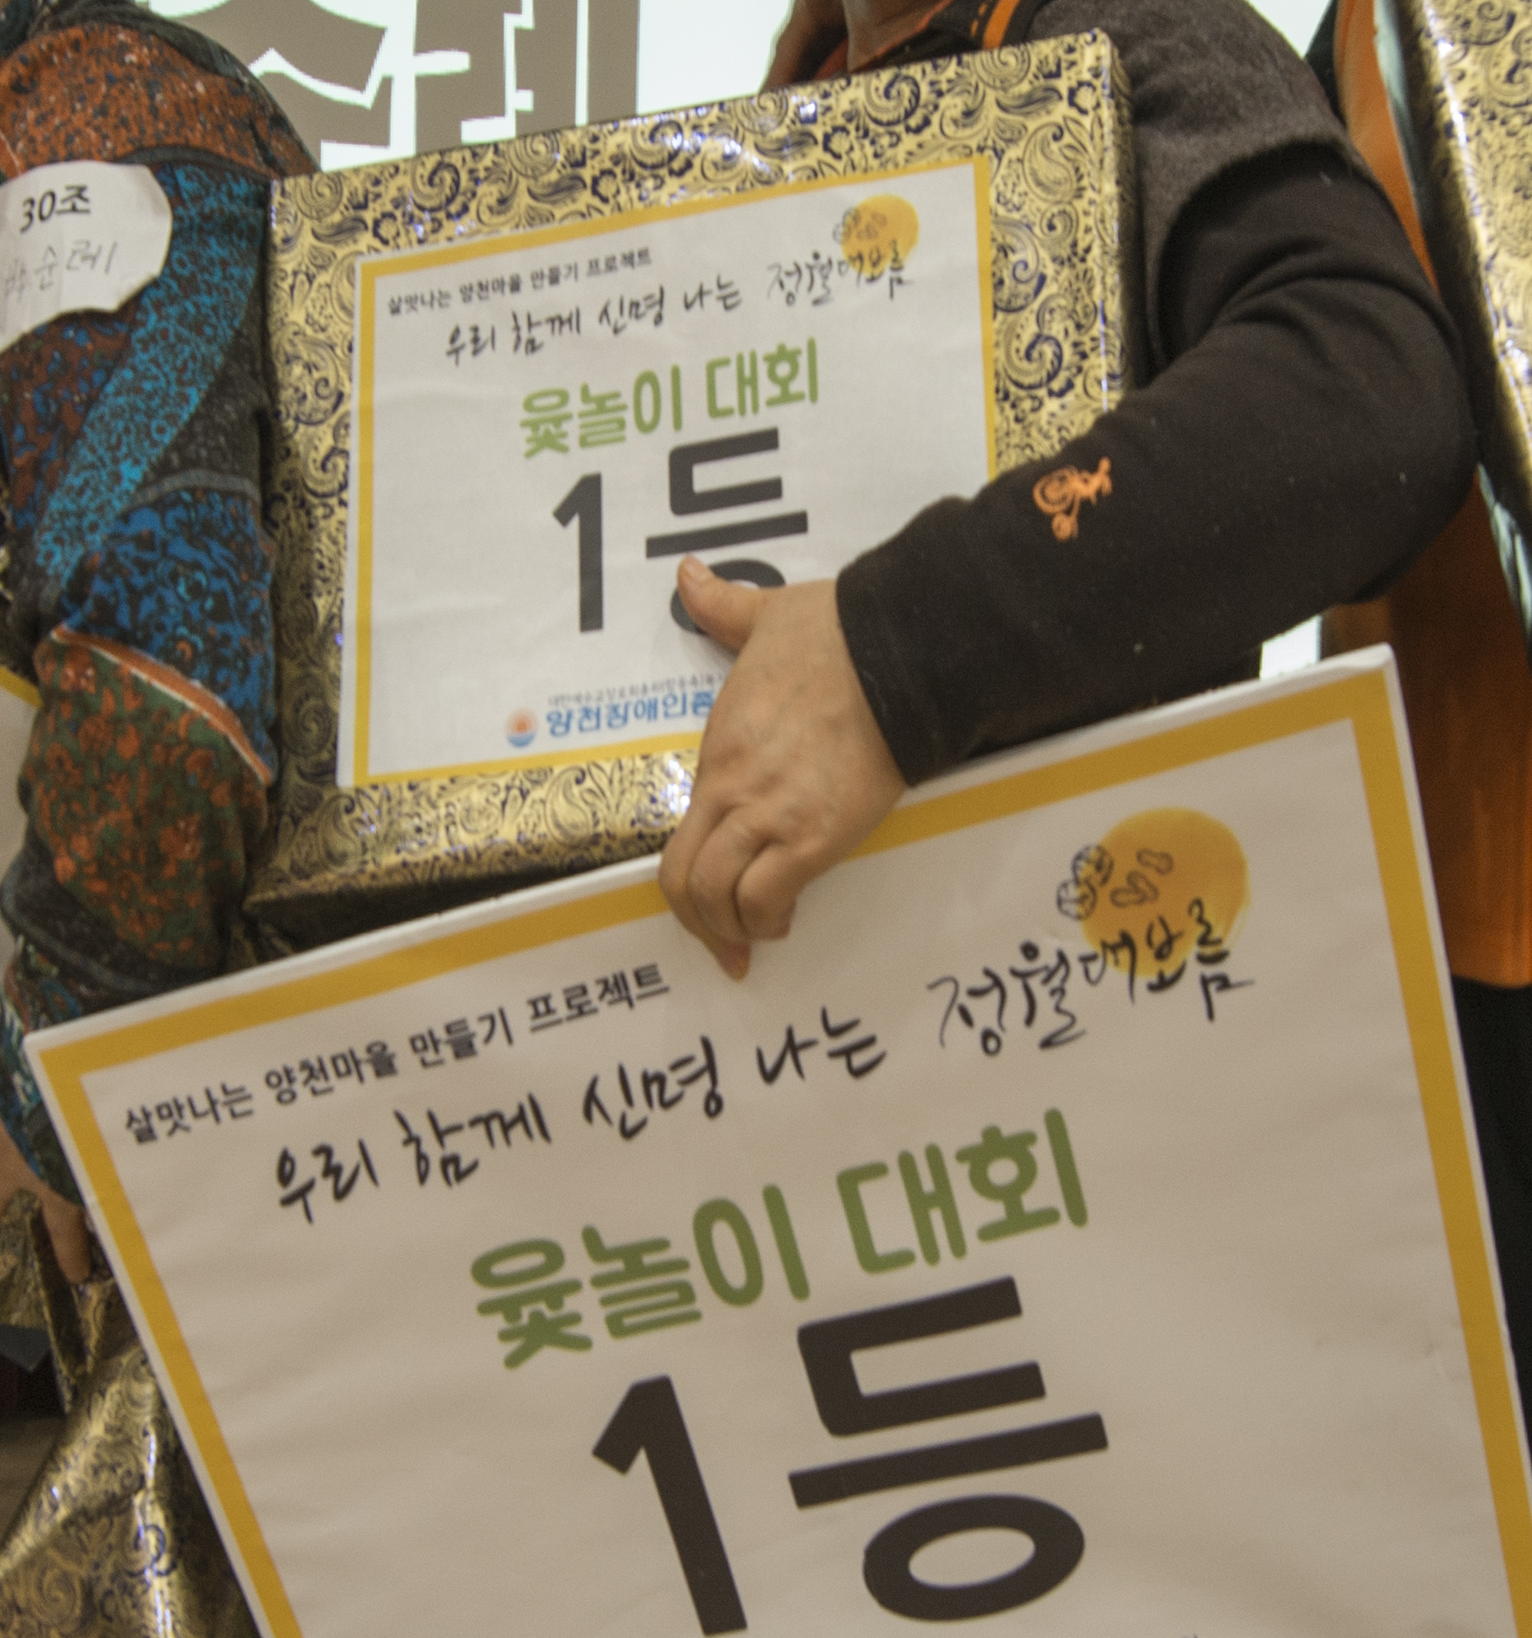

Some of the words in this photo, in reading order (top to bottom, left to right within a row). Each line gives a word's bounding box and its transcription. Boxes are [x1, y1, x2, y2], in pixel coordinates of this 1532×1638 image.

[20, 184, 92, 234] 30조
[444, 325, 497, 367] 우리
[510, 307, 581, 357] 함께
[597, 286, 666, 337] 신명
[682, 274, 742, 312] 나는
[519, 364, 683, 459] 윷놀이
[705, 336, 819, 420] 대회
[552, 427, 809, 633] 1등
[125, 1081, 255, 1148] 살맛나는
[264, 1038, 400, 1106] 양천마을
[407, 1006, 516, 1076] 만들기
[526, 964, 672, 1034] 프로젝트
[276, 1134, 380, 1225] 우리
[398, 1090, 552, 1190] 함께
[581, 1035, 726, 1141] 신명
[755, 1005, 888, 1091] 나는
[468, 1183, 811, 1370] 윷놀이
[836, 1107, 1090, 1275] 대회
[590, 1274, 1110, 1638] 1등
